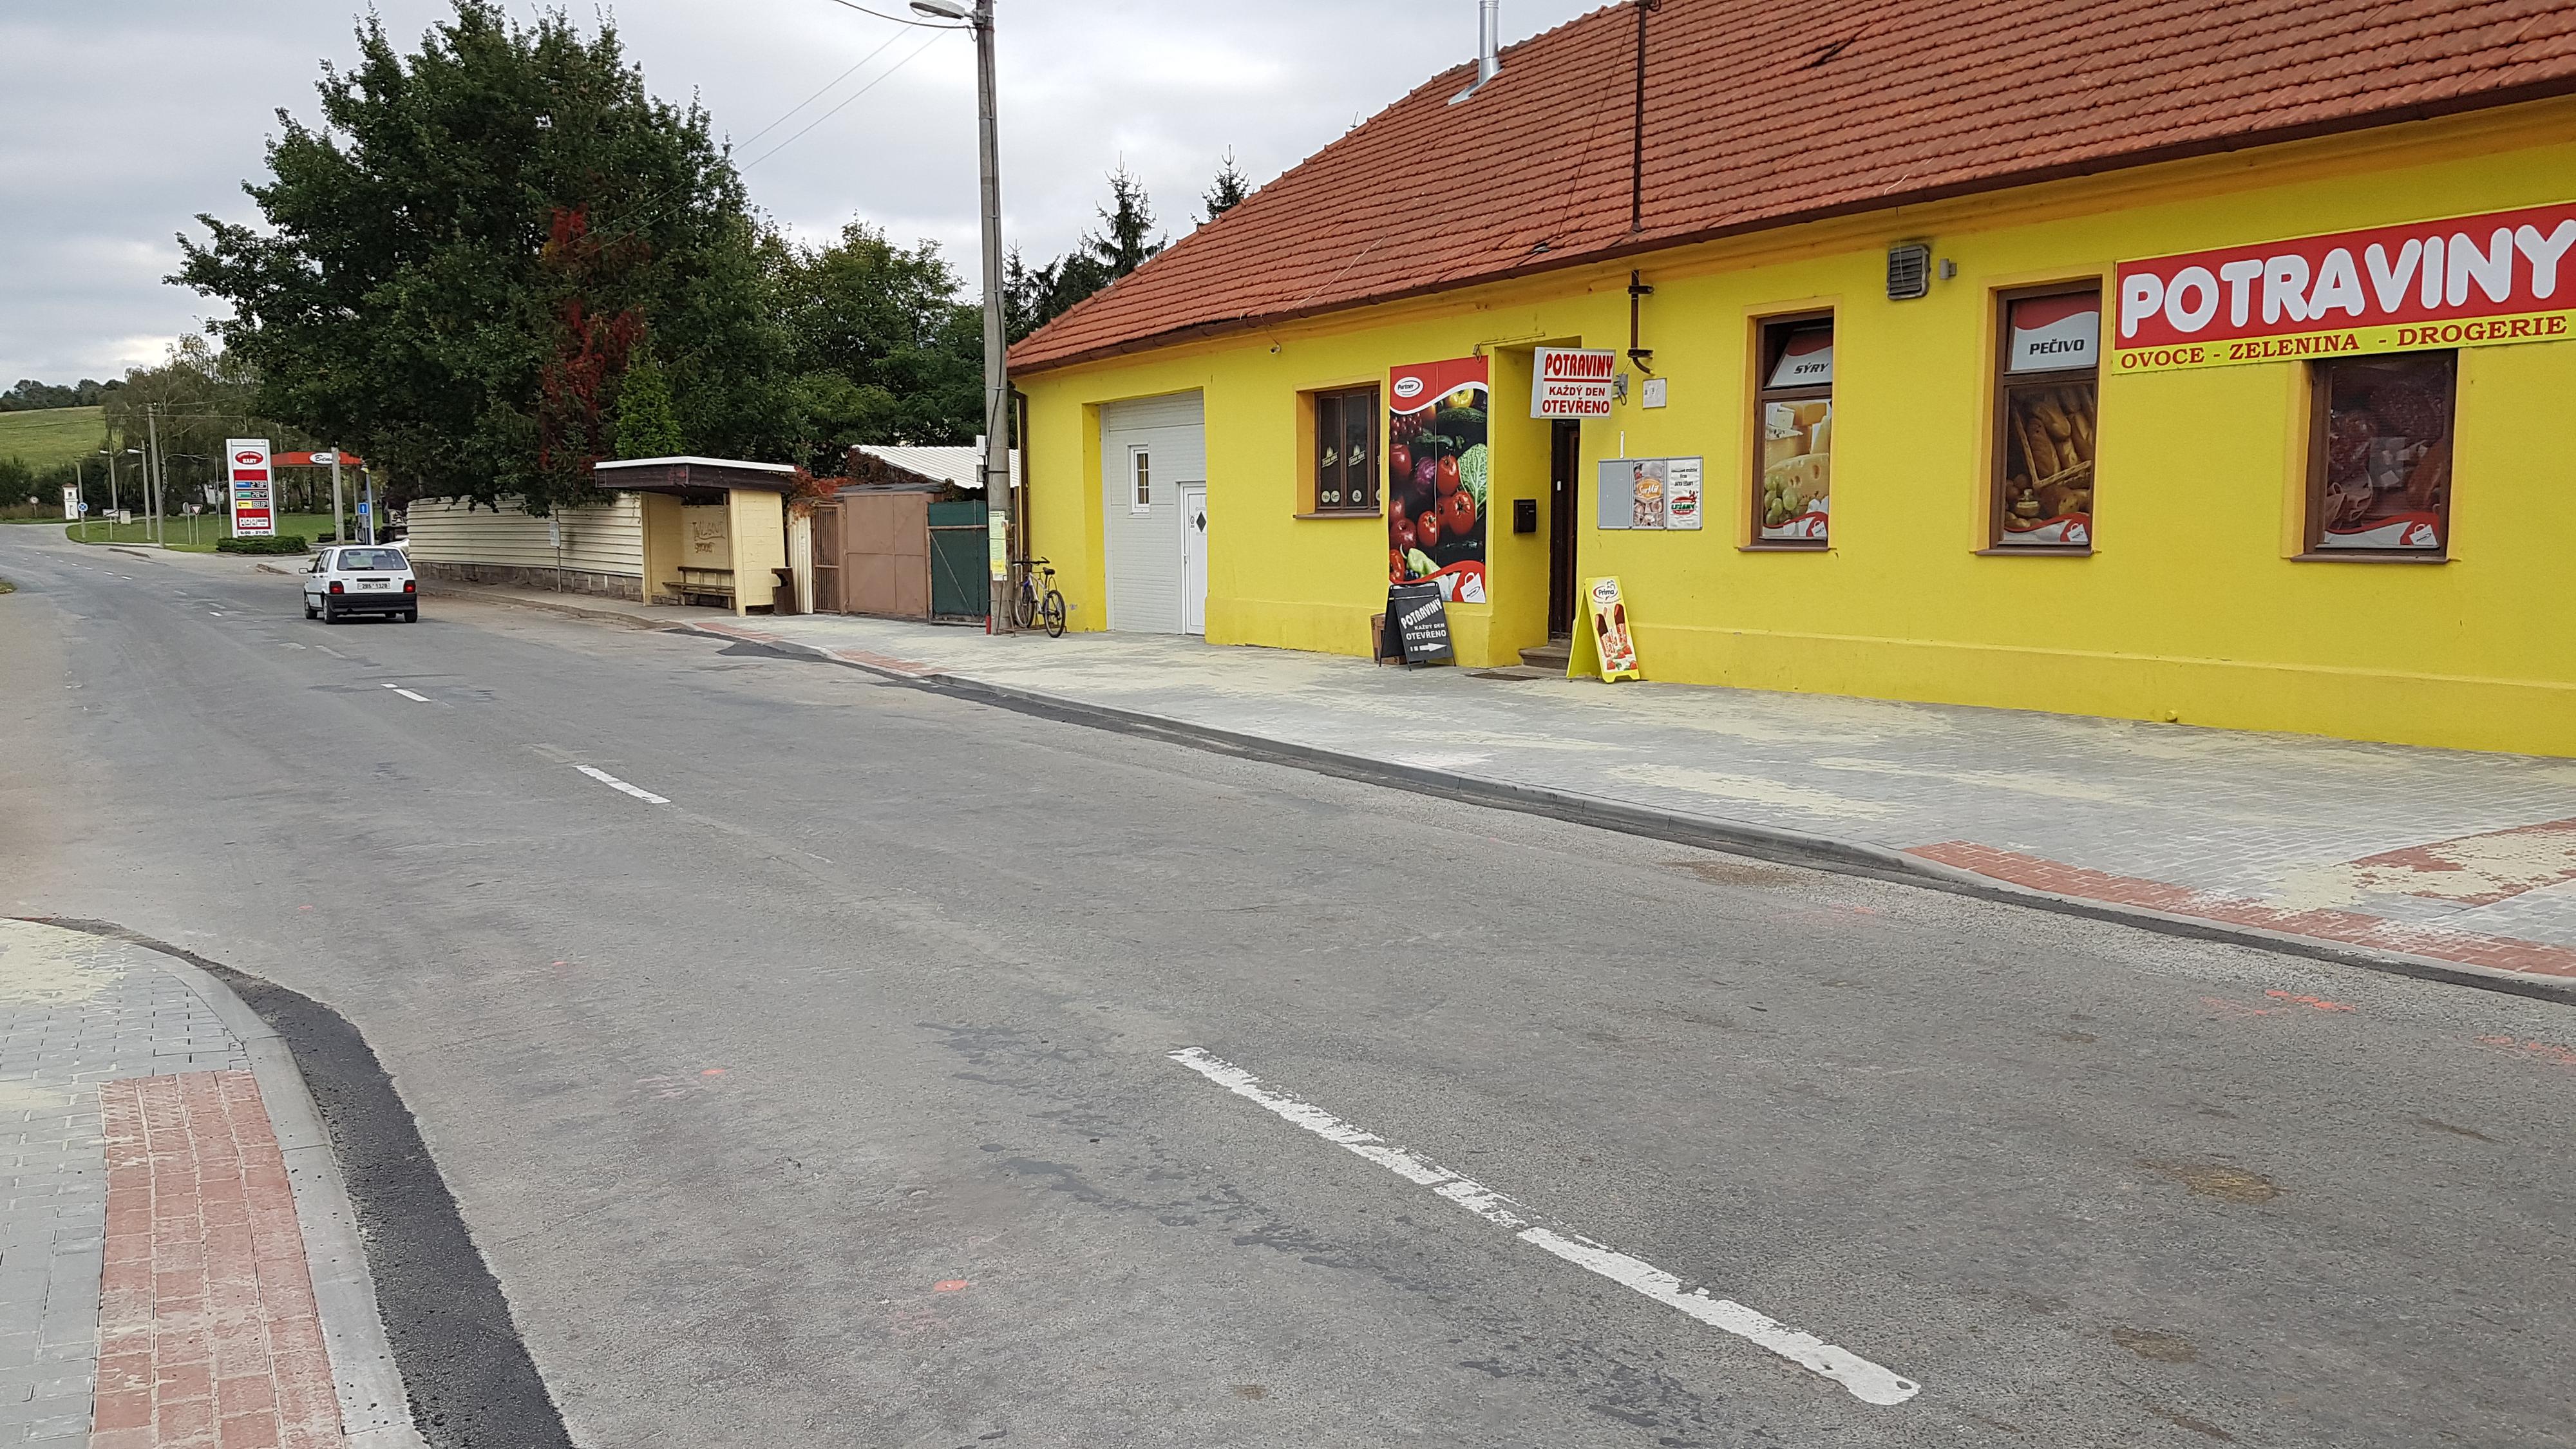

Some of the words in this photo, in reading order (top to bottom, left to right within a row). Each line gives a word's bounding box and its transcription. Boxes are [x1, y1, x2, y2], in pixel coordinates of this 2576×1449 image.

[2121, 219, 2576, 338] POTRAVINY
[2029, 338, 2085, 355] PEČIVO
[2121, 348, 2205, 369] OVOCE
[2229, 334, 2360, 361] ZELENINA
[2397, 316, 2567, 346] DROGERIE
[1544, 354, 1614, 377] POTRAVINY
[1794, 362, 1829, 374] SÝRY
[1549, 384, 1583, 396] KAŽDÝ
[1586, 387, 1605, 396] DEN
[1542, 397, 1610, 413] OTEVŘENO
[1401, 598, 1443, 629] POTRAVINY
[1406, 629, 1446, 640] OTEVŘENO
